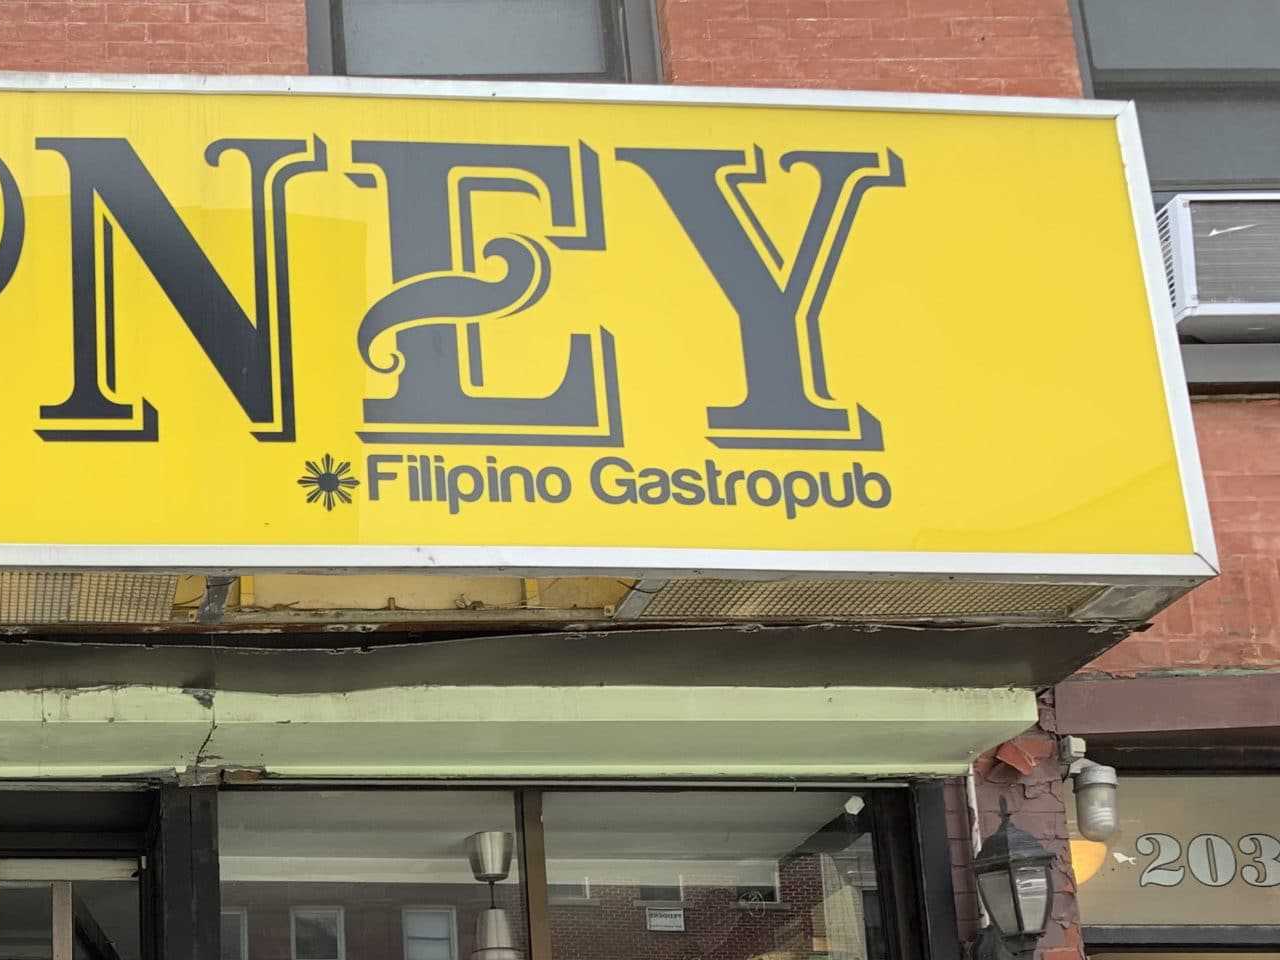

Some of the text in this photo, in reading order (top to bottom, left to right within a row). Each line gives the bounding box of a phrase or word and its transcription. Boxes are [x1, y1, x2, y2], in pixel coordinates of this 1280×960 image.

[367, 453, 893, 520] Filipino Gastropub
[1135, 832, 1280, 888] 203
